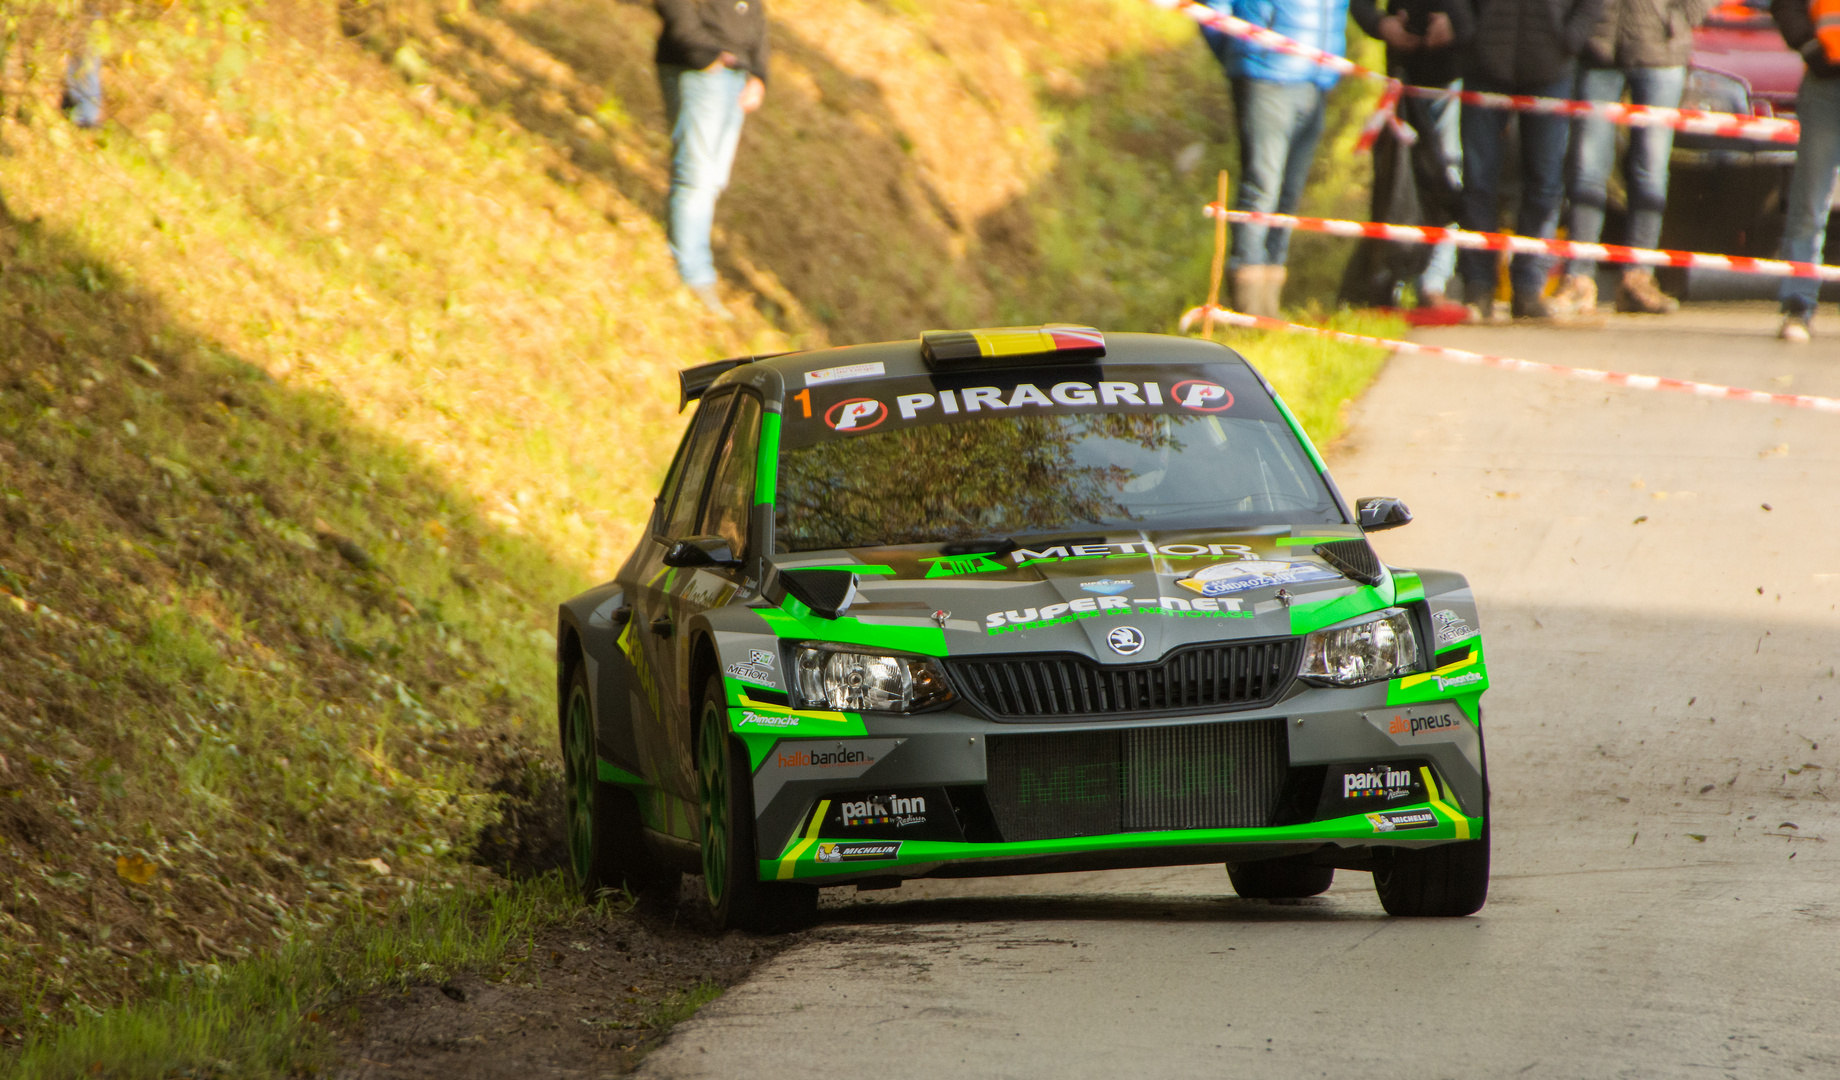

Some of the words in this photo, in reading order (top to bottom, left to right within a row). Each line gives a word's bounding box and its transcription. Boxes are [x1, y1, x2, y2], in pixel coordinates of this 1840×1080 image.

[793, 388, 812, 419] 1
[896, 381, 1164, 419] PIRAGRI
[1181, 383, 1226, 408] P
[834, 399, 880, 431] P
[1010, 540, 1260, 563] METIOR
[1202, 572, 1297, 593] CONDROZ-HUY
[987, 609, 1101, 637] ENTREPRISE
[1106, 606, 1133, 616] DE
[1138, 606, 1255, 620] NETTOYAGE
[1438, 625, 1472, 643] METIOR
[727, 664, 768, 681] METIOR
[1343, 767, 1383, 798] park
[1385, 766, 1411, 787] inn
[841, 797, 888, 827] park
[889, 793, 926, 814] inn
[1391, 813, 1433, 823] MICHELIN
[843, 846, 897, 855] MICHELIN
